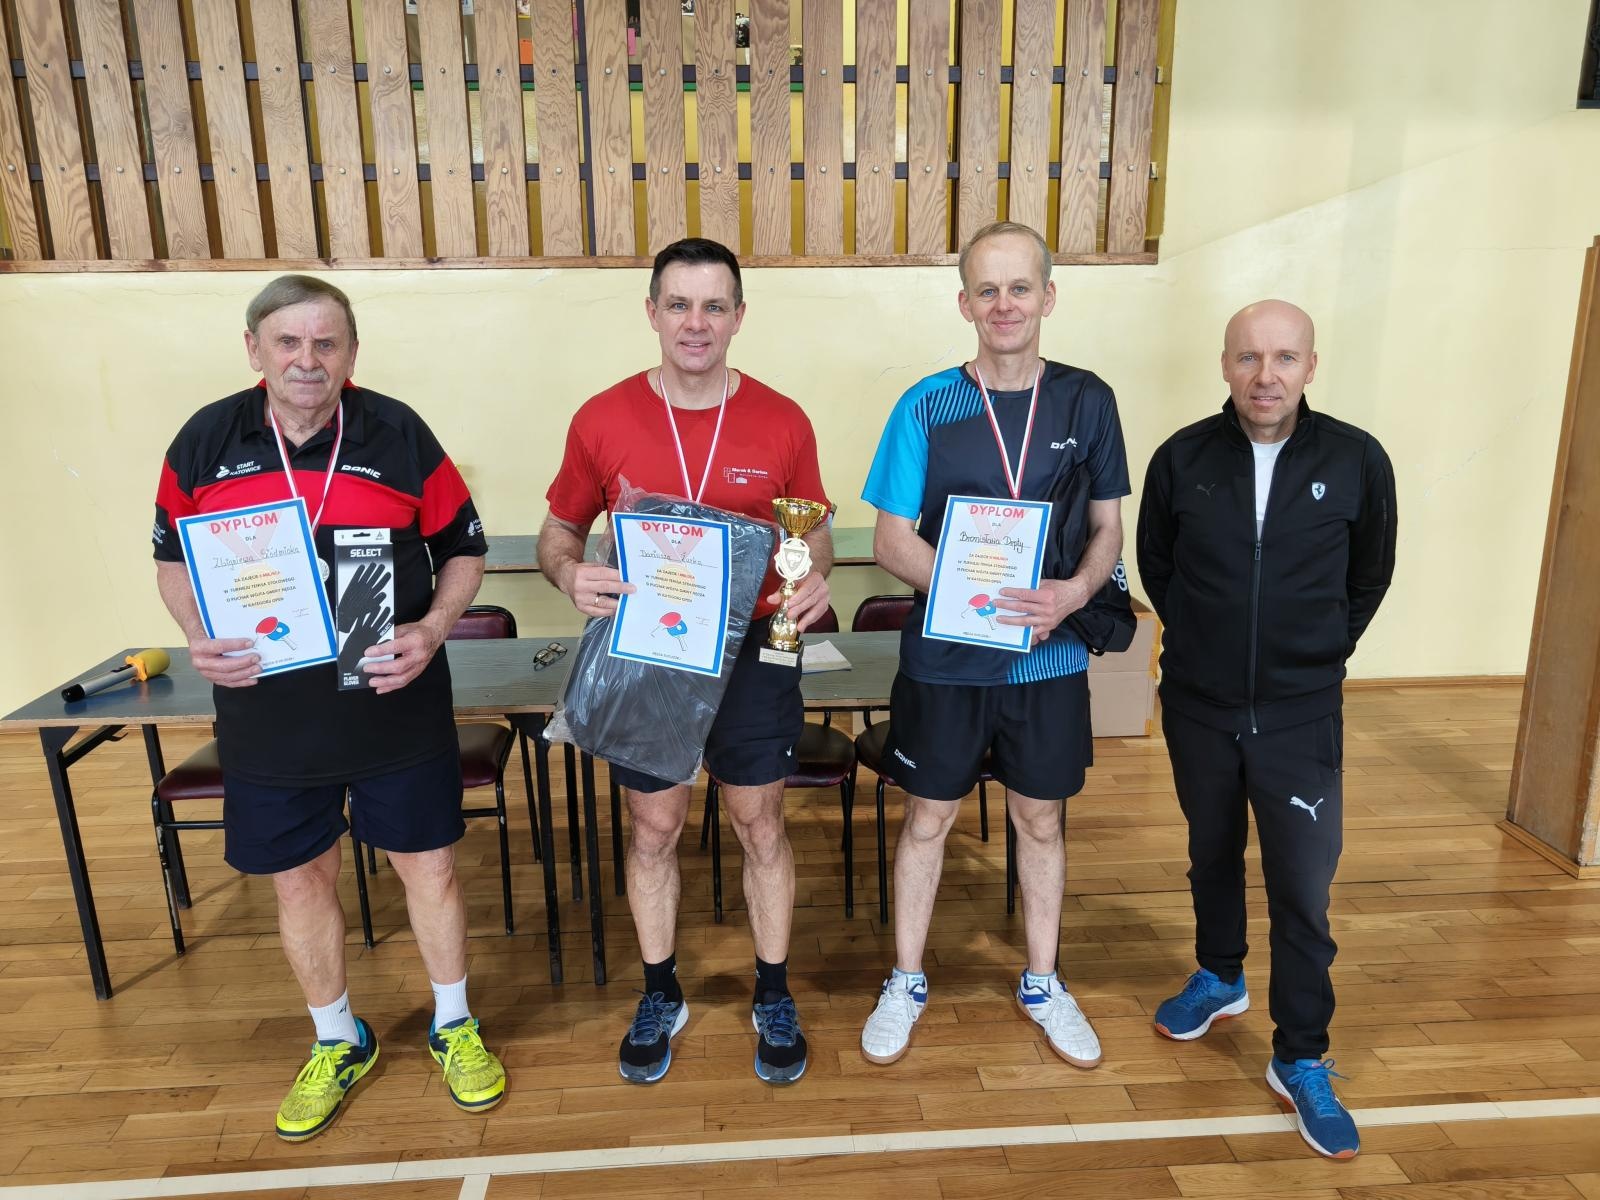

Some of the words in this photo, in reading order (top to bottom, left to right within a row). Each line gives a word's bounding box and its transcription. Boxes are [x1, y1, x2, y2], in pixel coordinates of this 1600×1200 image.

[230, 465, 260, 475] KATOWICE
[236, 461, 254, 470] START
[341, 464, 381, 478] DONIC
[969, 504, 1025, 519] DYPLOM
[210, 512, 278, 535] DYPLOM
[641, 521, 703, 537] DYPLOM
[350, 548, 382, 558] SELECT
[894, 749, 916, 769] DONIC
